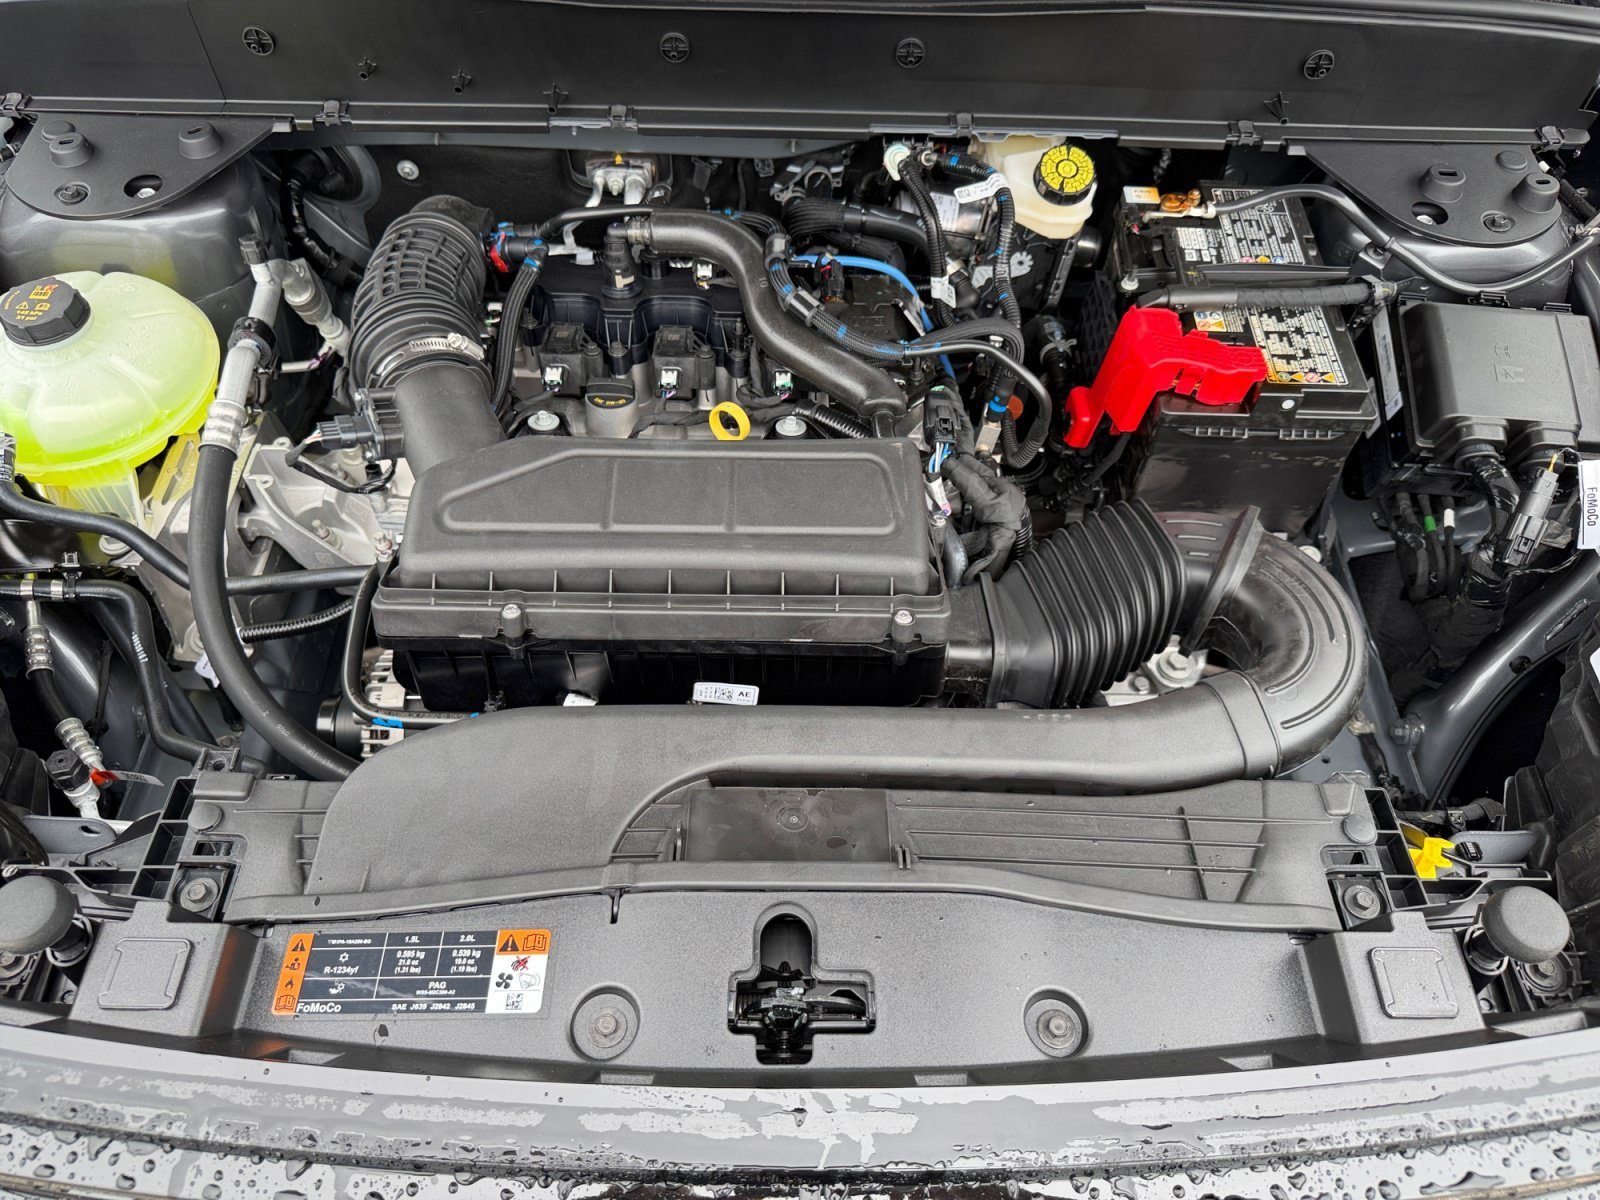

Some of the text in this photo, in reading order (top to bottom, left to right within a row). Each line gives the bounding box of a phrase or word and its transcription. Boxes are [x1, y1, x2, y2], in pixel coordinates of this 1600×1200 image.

[1587, 487, 1599, 527] FoMoCo
[405, 935, 420, 943] 1.5L
[459, 934, 476, 942] 2.0L
[416, 950, 425, 960] kg
[472, 949, 481, 959] kg
[323, 965, 359, 976] R-1234yf
[409, 966, 421, 975] lbs)
[465, 965, 478, 974] lbs)
[428, 981, 447, 989] PAG
[296, 1003, 342, 1013] FoMoCo
[430, 1002, 451, 1010] J2842
[454, 1002, 476, 1010] J2845
